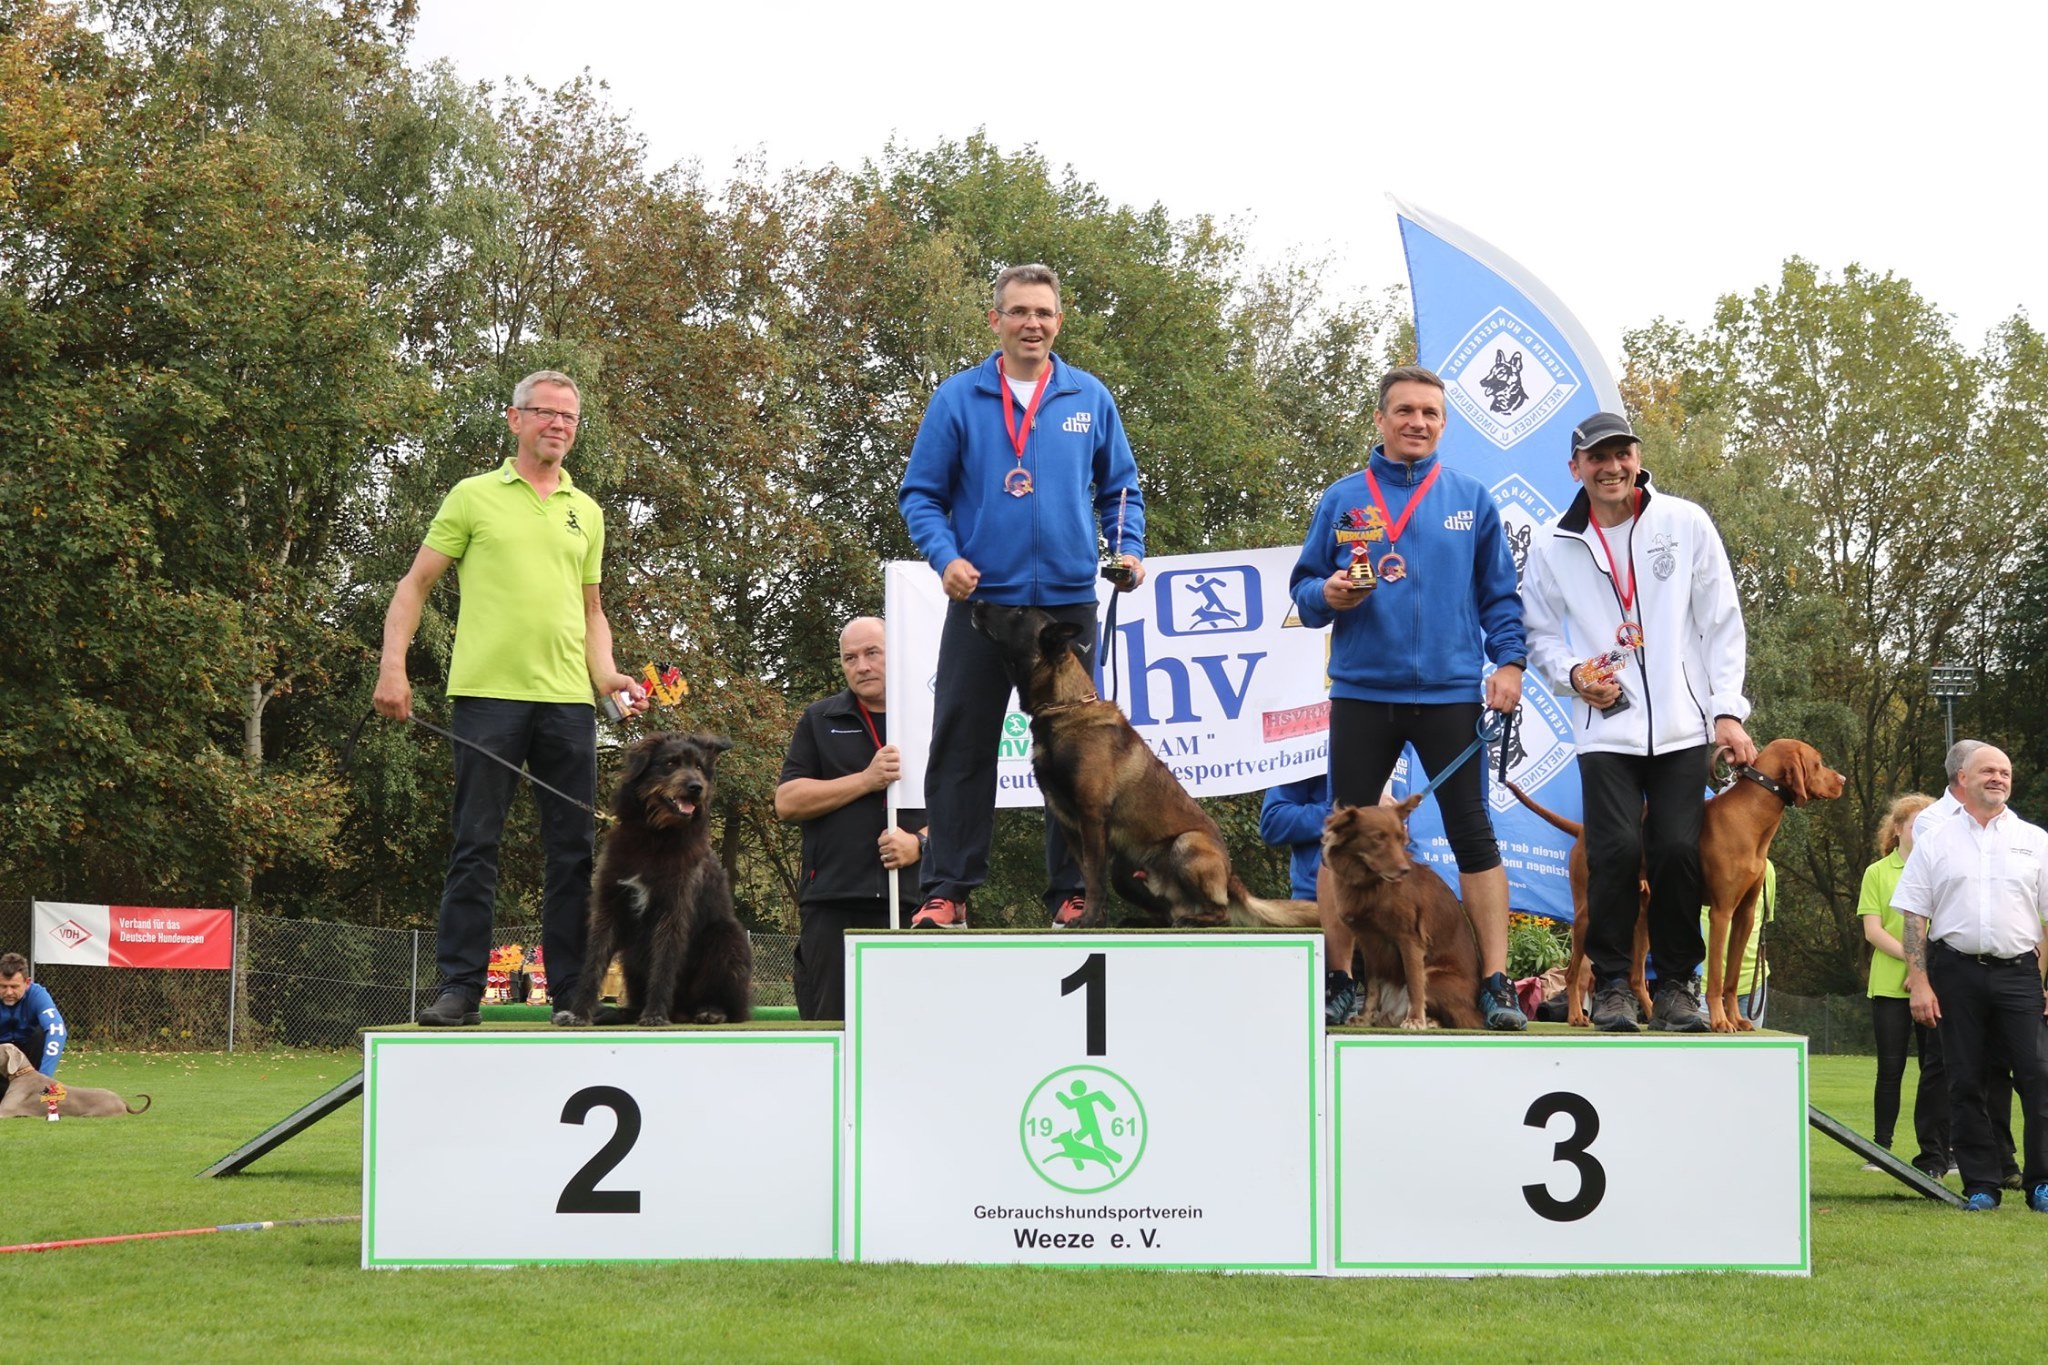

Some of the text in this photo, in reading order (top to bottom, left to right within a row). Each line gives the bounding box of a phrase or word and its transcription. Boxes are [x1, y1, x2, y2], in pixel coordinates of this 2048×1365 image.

[1063, 417, 1091, 433] dhv
[1444, 515, 1473, 530] dhv
[119, 917, 181, 930] Verband für das
[59, 928, 80, 939] VDH
[120, 931, 204, 944] Deutsche Hundewesen
[1061, 953, 1106, 1056] 1
[1026, 1117, 1136, 1138] 19 61
[555, 1085, 642, 1214] 2
[1522, 1091, 1607, 1222] 3
[973, 1204, 1203, 1221] Gebrauchshundsportverein
[1014, 1228, 1095, 1249] Weeze
